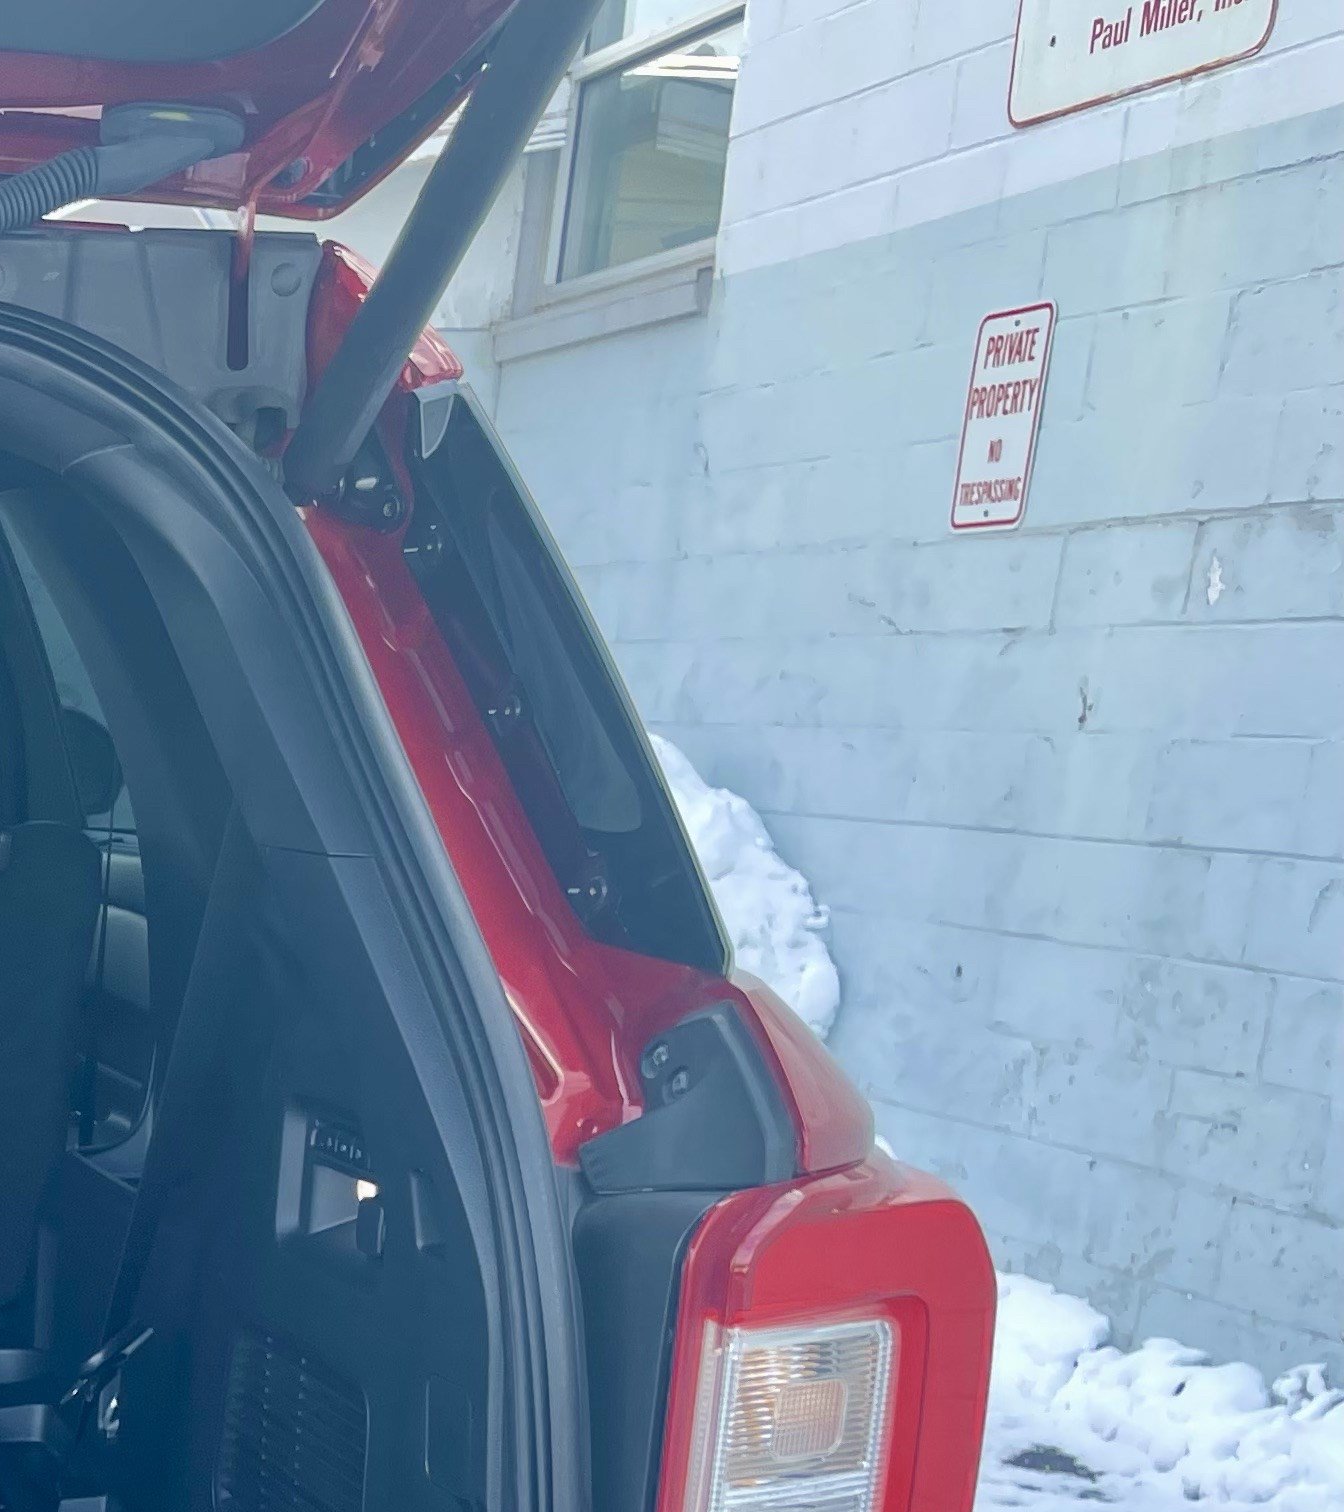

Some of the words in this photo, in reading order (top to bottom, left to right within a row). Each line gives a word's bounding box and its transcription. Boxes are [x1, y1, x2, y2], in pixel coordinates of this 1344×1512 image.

[1089, 7, 1132, 54] Paul
[1140, 0, 1203, 37] Miller,
[983, 327, 1040, 369] PRIVATE
[968, 378, 1038, 420] PROPERTY
[987, 438, 1003, 463] NO
